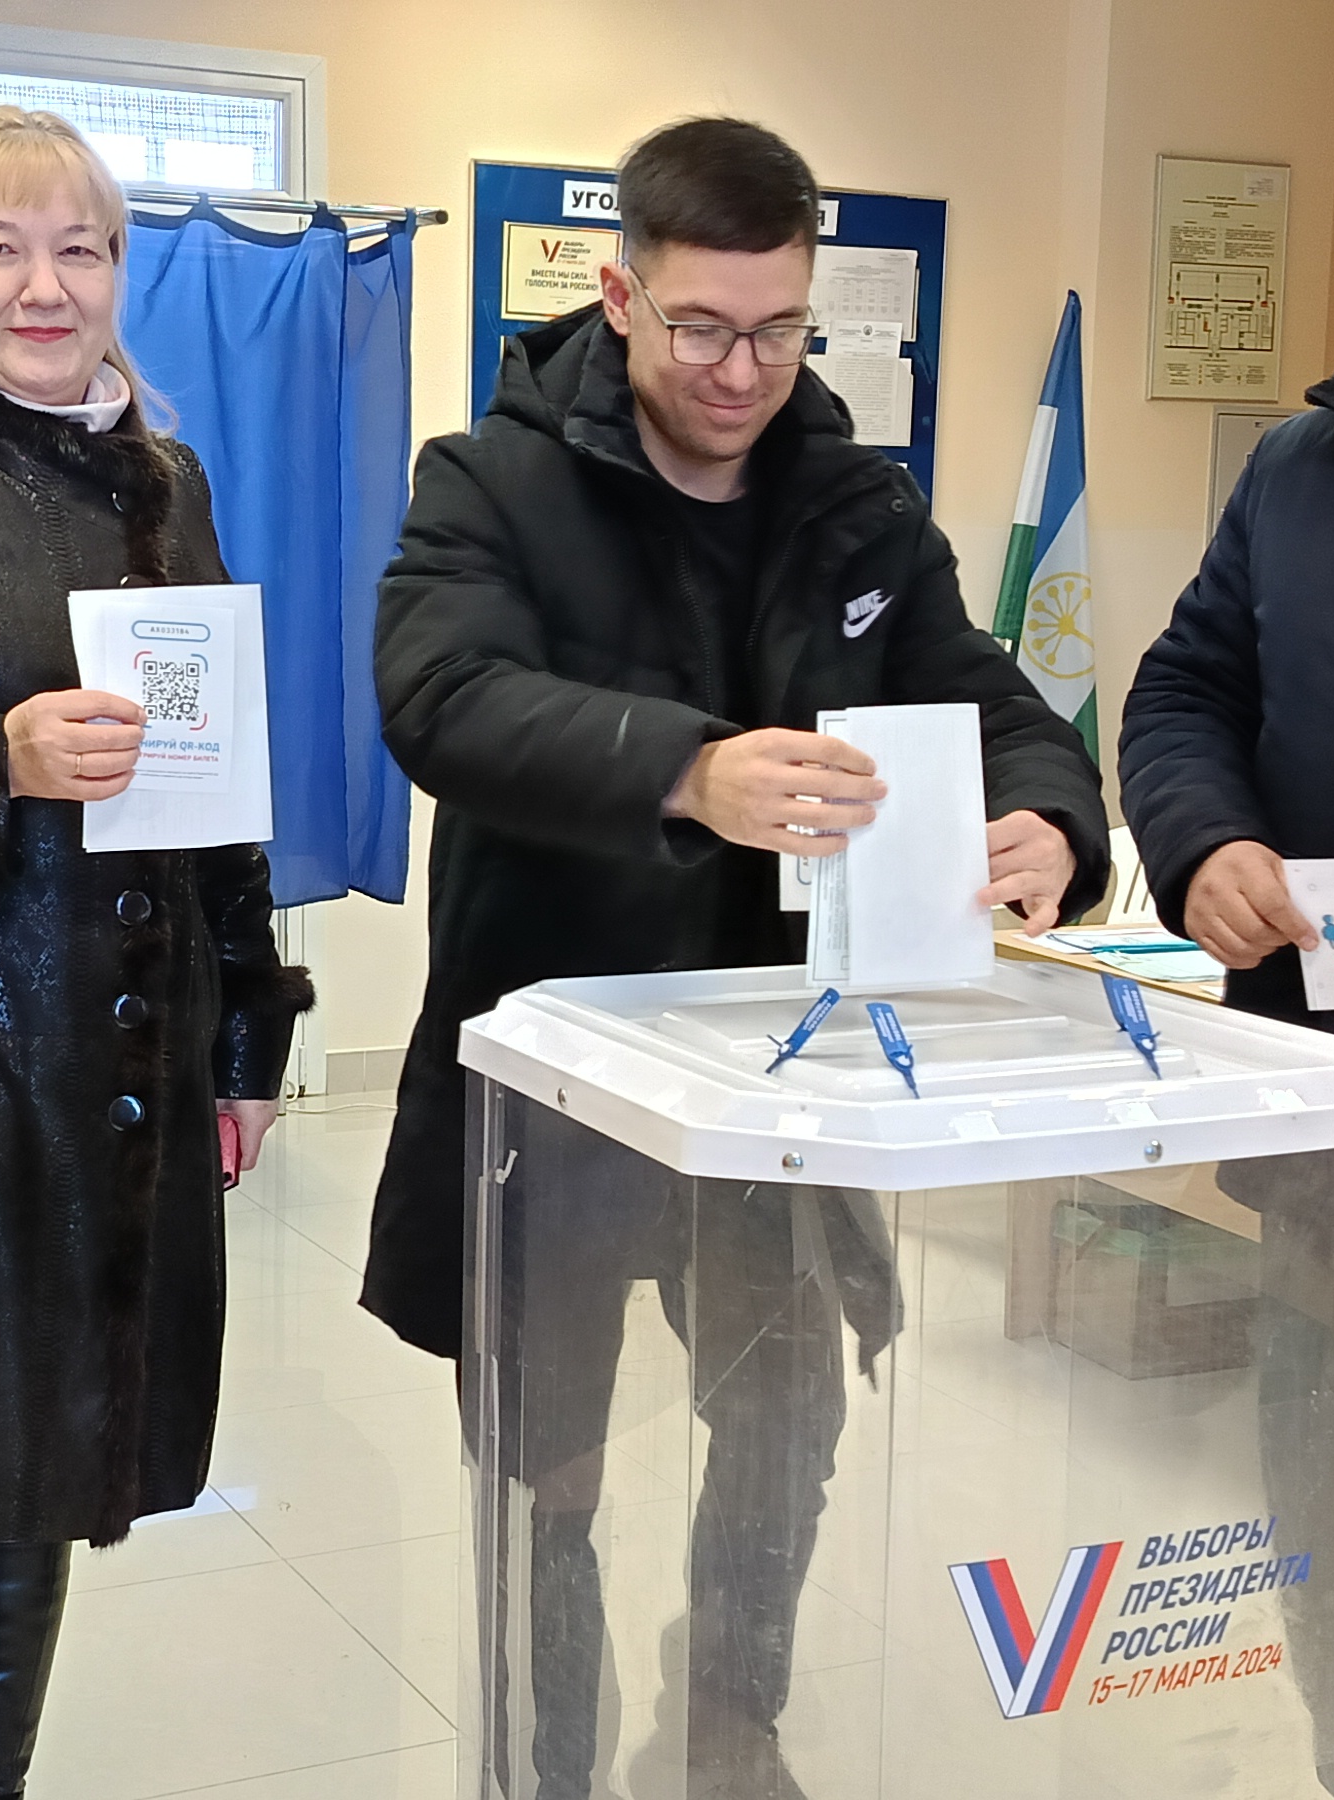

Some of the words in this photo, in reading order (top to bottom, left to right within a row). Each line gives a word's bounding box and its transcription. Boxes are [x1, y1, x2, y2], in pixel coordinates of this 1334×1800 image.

[571, 189, 620, 211] УГО
[524, 279, 559, 289] ГОЛОСУЕМ
[560, 281, 569, 289] ЗА
[531, 268, 556, 279] ВМЕСТЕ
[557, 270, 570, 279] МЫ
[570, 271, 588, 280] СИЛА
[846, 588, 885, 622] NIKE
[140, 738, 177, 749] НИРУЙ
[179, 741, 220, 752] QR-КОД
[1136, 1516, 1278, 1570] ВЫБОРЫ
[1118, 1552, 1313, 1617] ПРЕЗИДЕНТА
[1101, 1612, 1232, 1664] РОССИИ
[1152, 1653, 1230, 1694] МАРТА
[1230, 1642, 1284, 1679] 2024
